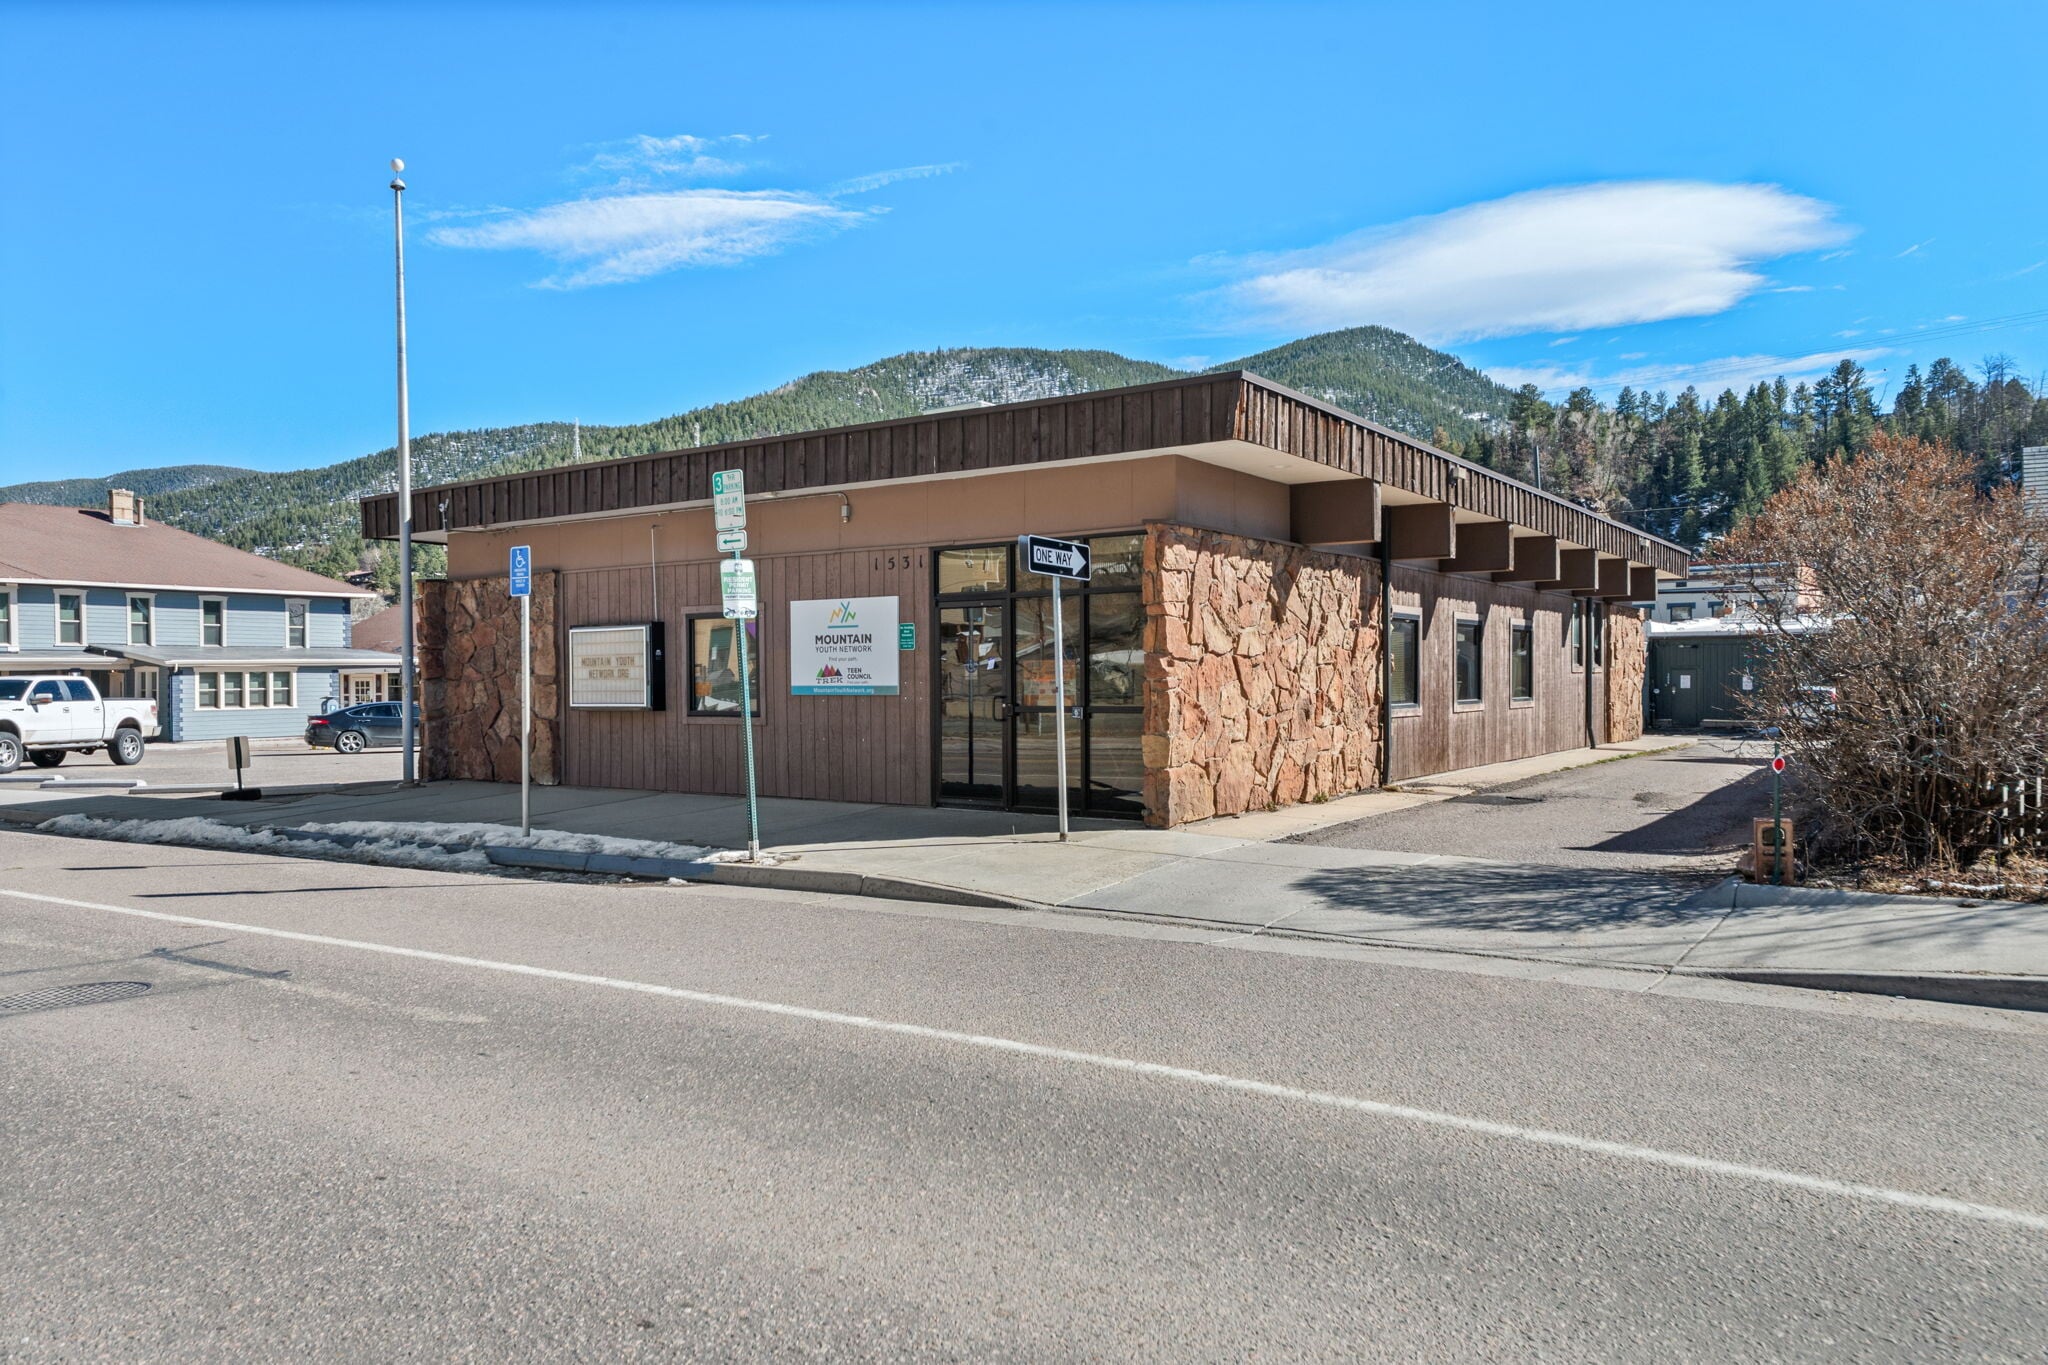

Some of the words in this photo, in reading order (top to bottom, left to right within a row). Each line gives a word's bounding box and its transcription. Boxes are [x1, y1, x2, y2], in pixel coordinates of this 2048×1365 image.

[715, 477, 722, 491] 3
[723, 482, 741, 490] PARKING
[731, 495, 738, 503] AM
[875, 554, 923, 571] 1531
[1035, 548, 1053, 564] ONE
[1055, 551, 1072, 566] WAY
[815, 633, 872, 645] MOUNTAIN
[815, 645, 838, 653] YOUTH
[839, 645, 872, 653] NETWORK
[581, 656, 611, 666] MOUNTAIN
[615, 656, 635, 666] YOUTH
